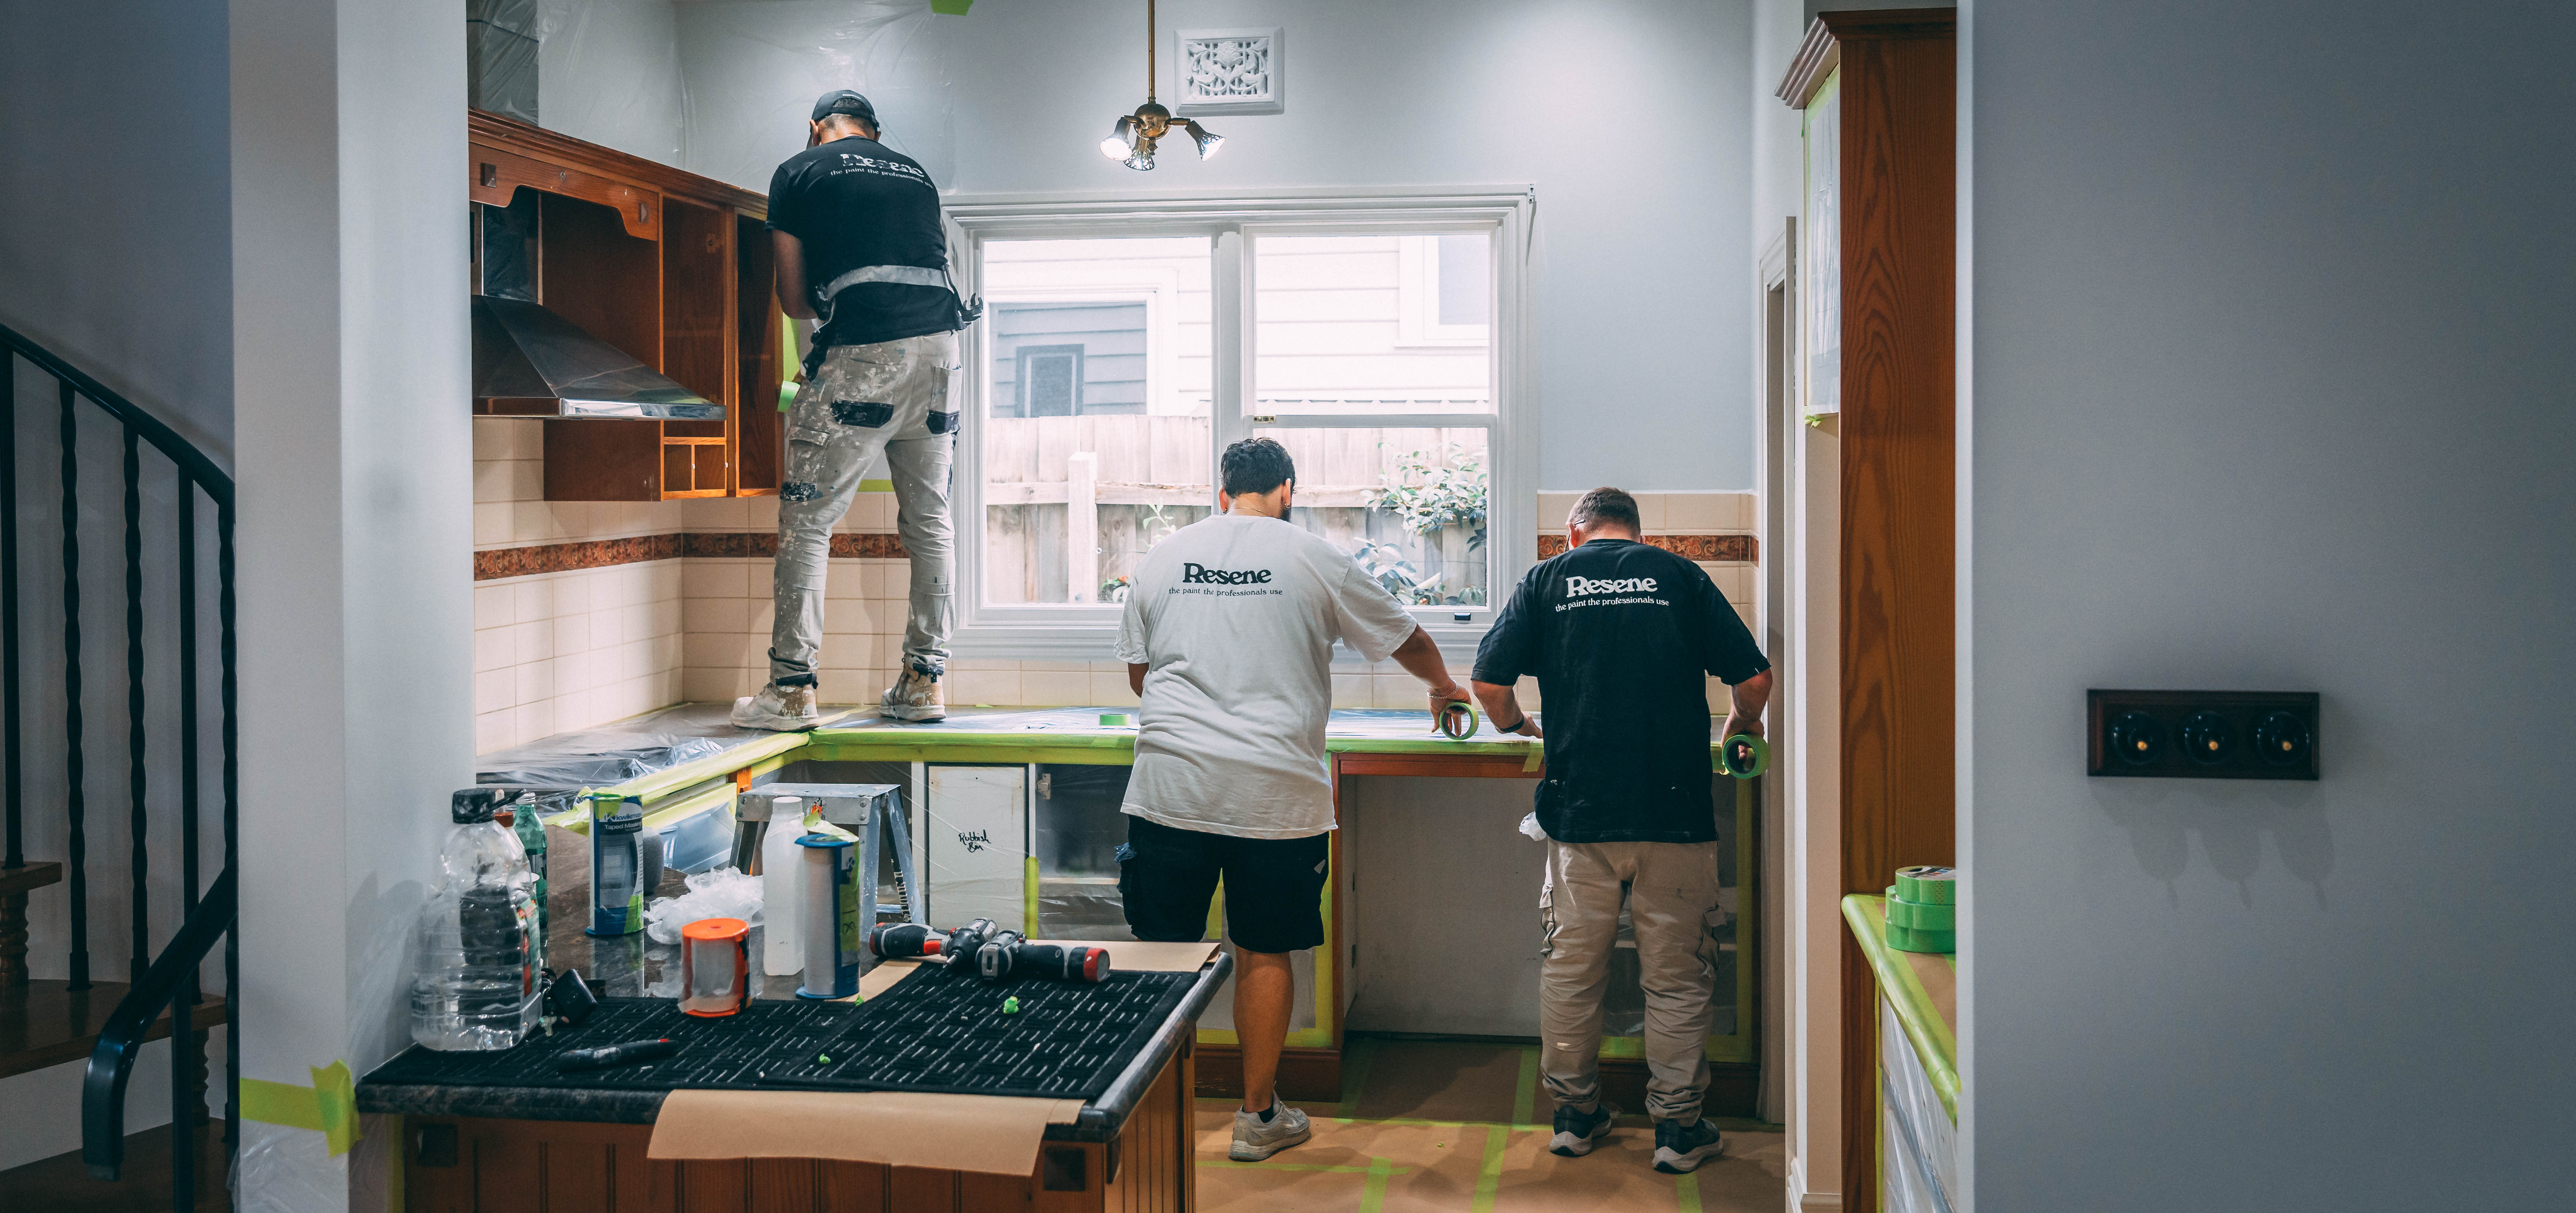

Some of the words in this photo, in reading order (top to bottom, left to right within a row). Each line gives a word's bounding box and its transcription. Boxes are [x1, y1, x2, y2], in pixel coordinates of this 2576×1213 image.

[881, 171, 923, 183] professionals
[1183, 563, 1271, 585] Resene
[1566, 576, 1657, 597] Resene
[1568, 600, 1586, 610] paint
[1602, 596, 1654, 606] professionals
[959, 829, 991, 845] Rubbish
[967, 842, 984, 853] Bin
